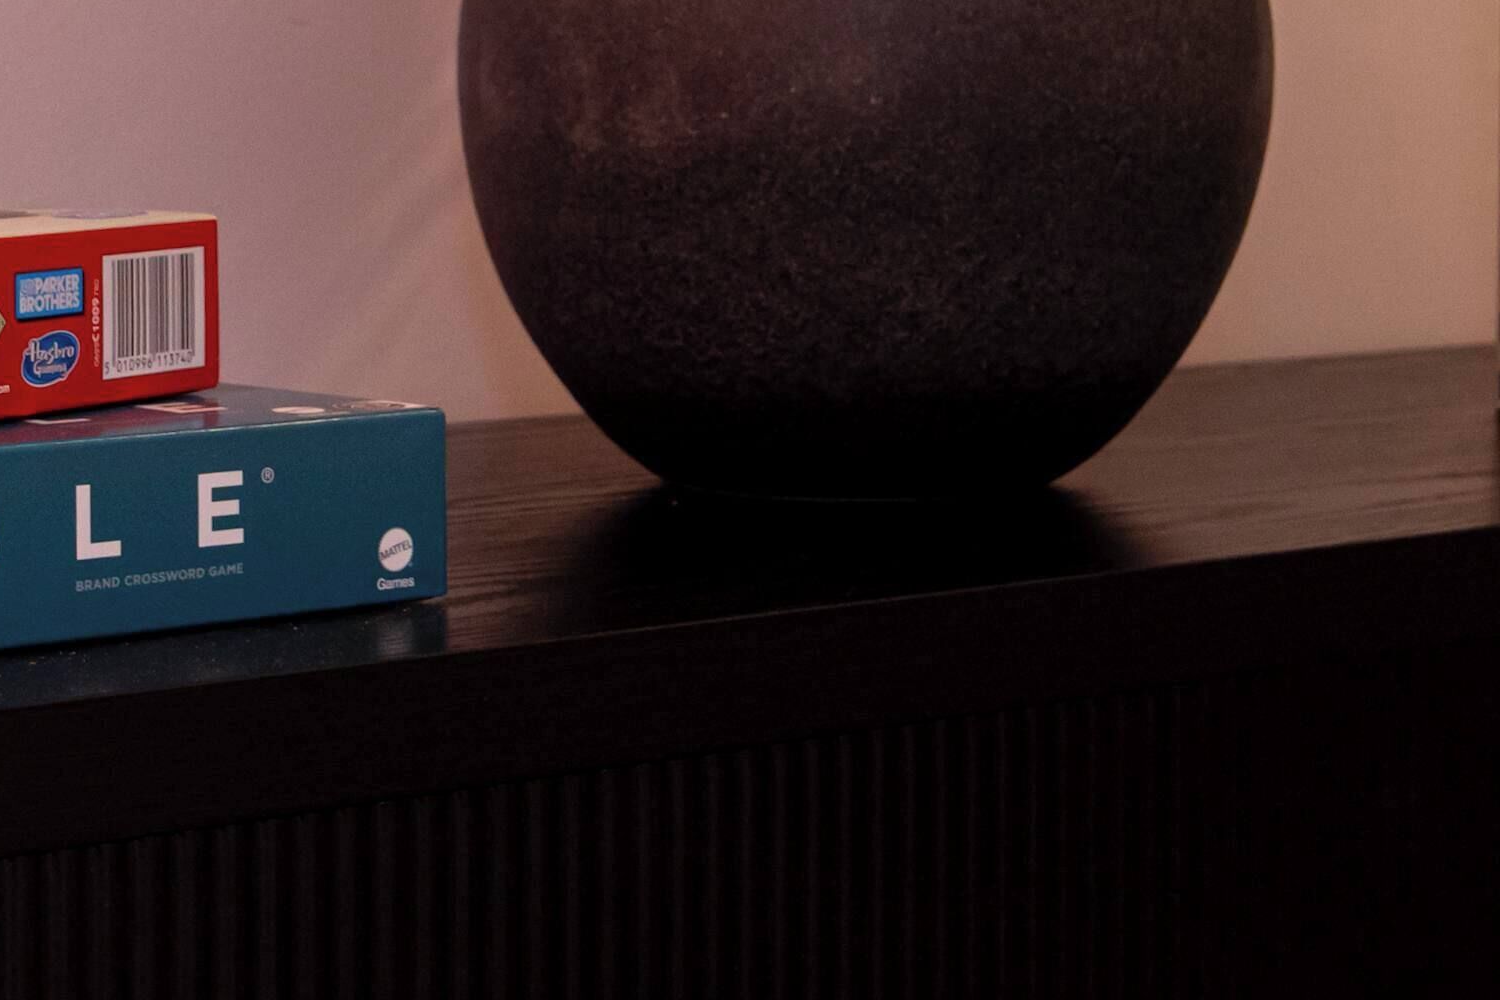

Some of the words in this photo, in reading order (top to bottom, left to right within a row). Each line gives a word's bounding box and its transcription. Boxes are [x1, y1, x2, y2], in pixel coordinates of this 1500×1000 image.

[35, 274, 80, 296] PARKER
[19, 292, 80, 314] BROTHERS
[25, 340, 75, 364] Hasbro
[379, 539, 413, 560] MATTEL
[75, 577, 120, 592] BRAND
[124, 567, 205, 586] CROSSWORD
[208, 562, 244, 577] GAME
[377, 577, 415, 590] Games
